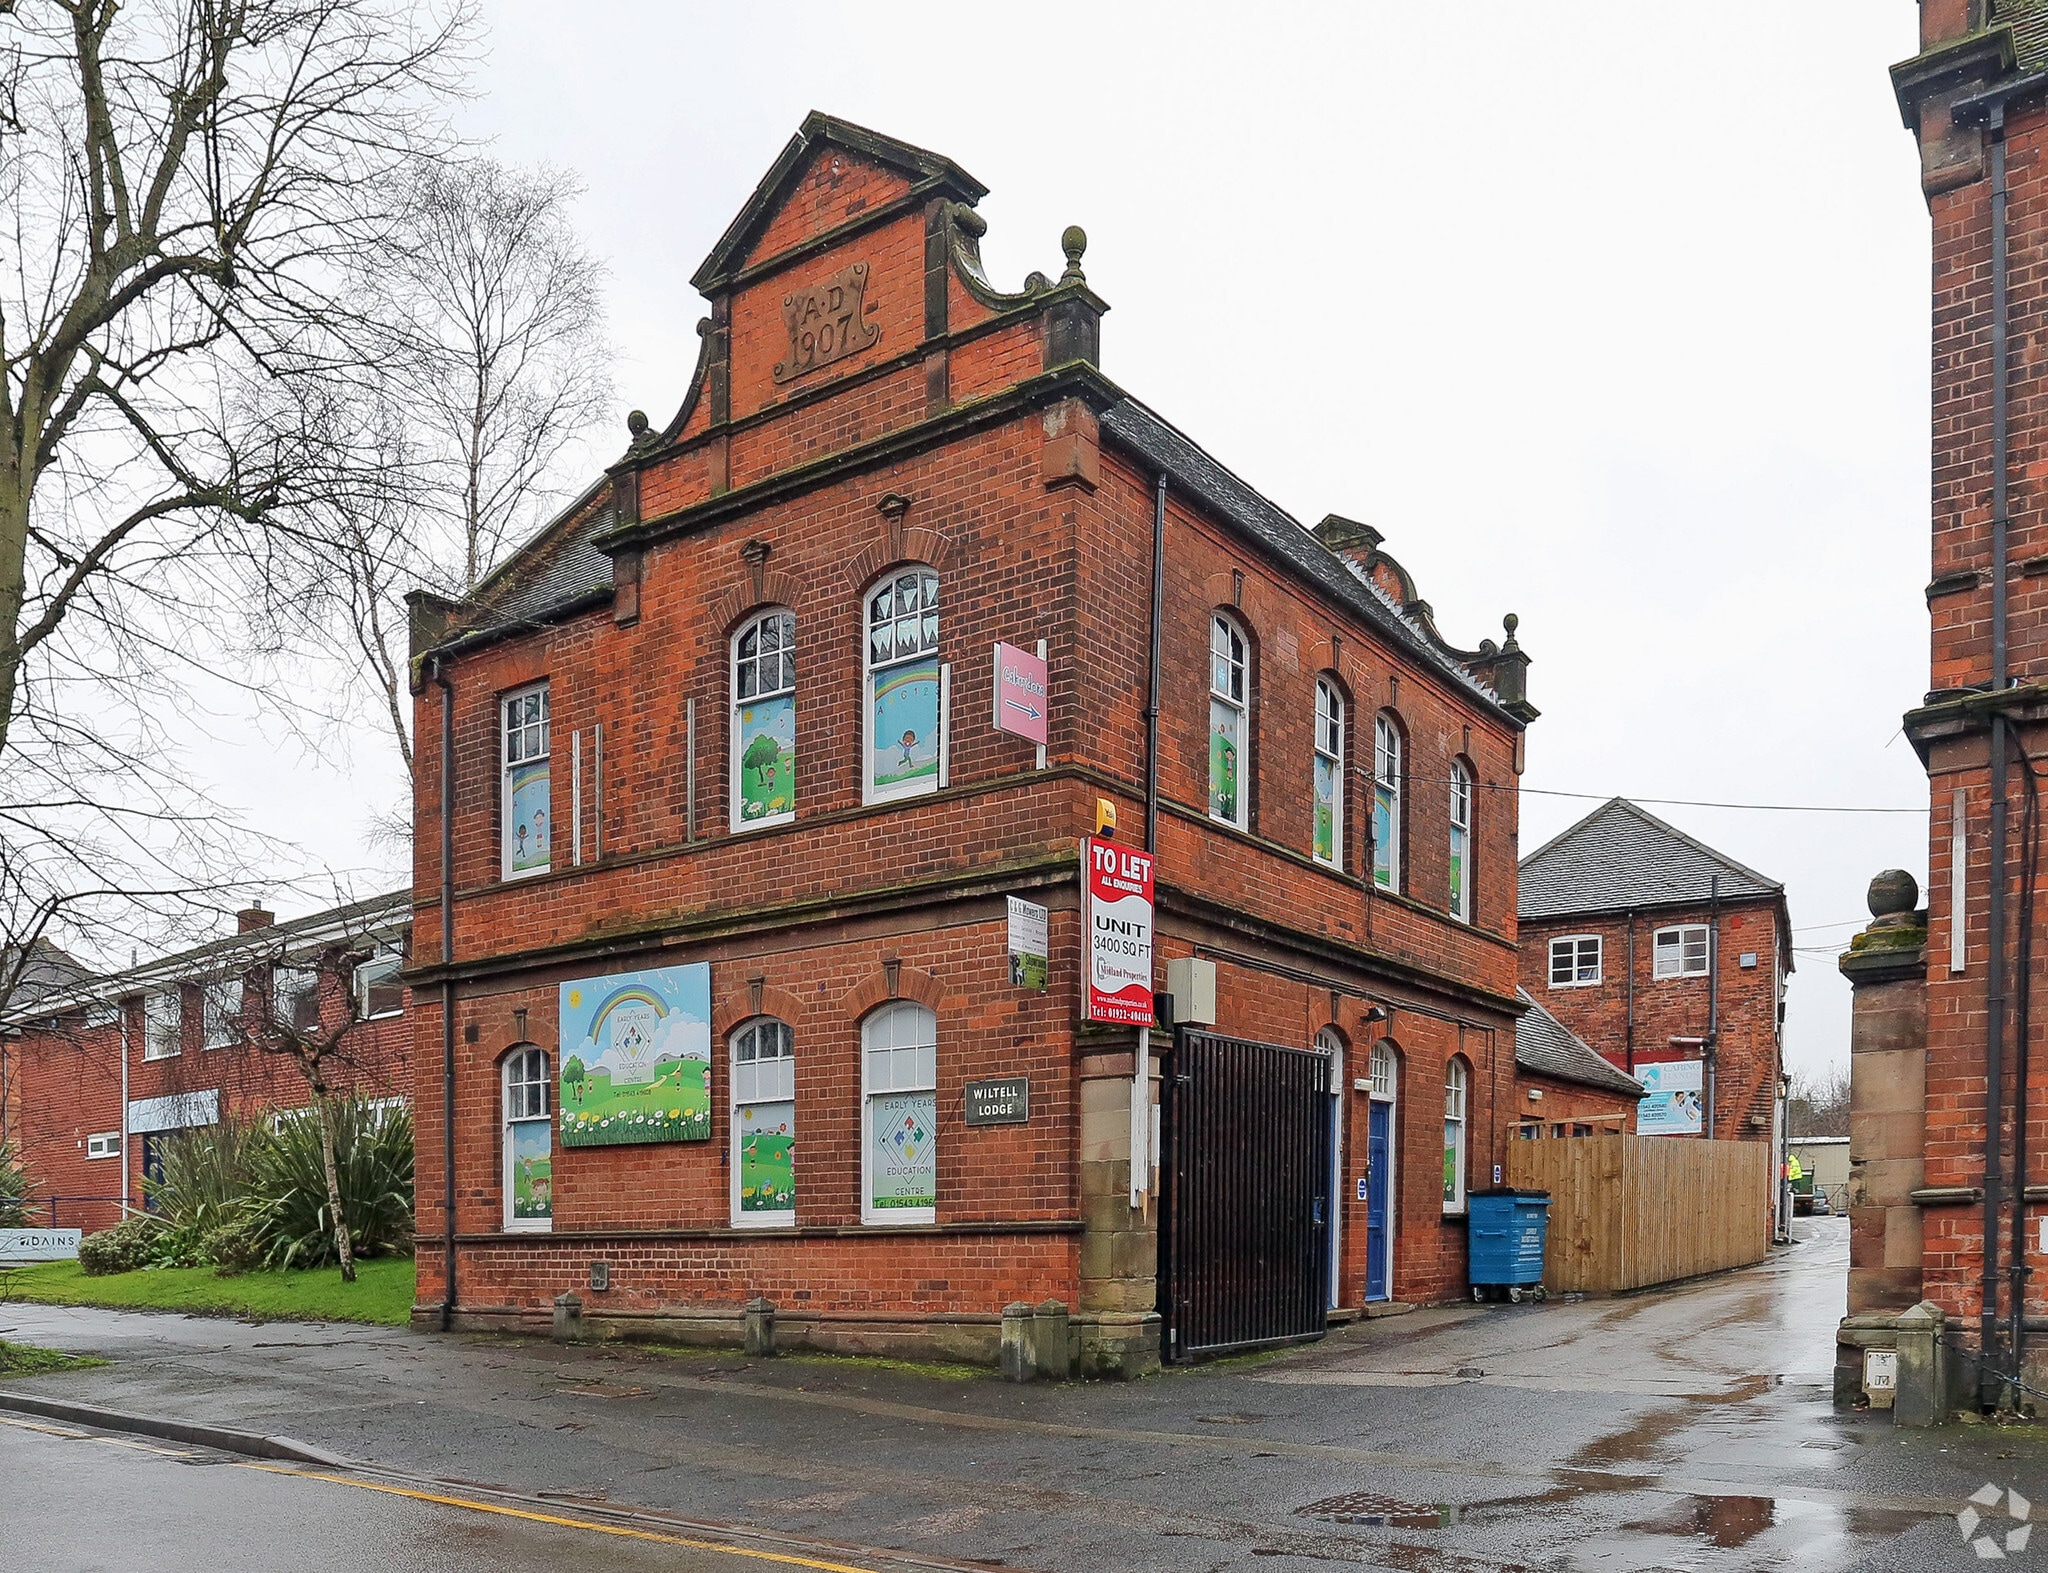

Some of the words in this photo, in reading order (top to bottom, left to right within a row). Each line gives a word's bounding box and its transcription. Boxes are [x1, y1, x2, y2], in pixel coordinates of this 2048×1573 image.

[1093, 845, 1117, 874] TO
[1121, 852, 1151, 882] LET
[1101, 875, 1113, 887] ALL
[1096, 915, 1146, 938] UNIT
[1094, 935, 1120, 953] 3400
[1122, 940, 1136, 957] SQ
[1138, 943, 1150, 959] FT
[1101, 964, 1122, 978] Midland
[1123, 968, 1148, 982] Properties
[1092, 1005, 1107, 1018] Tel:
[1663, 1062, 1700, 1072] CARING
[973, 1086, 1018, 1100] WILTELL
[884, 1101, 908, 1110] EARLY
[911, 1098, 936, 1108] YEARS
[978, 1103, 1013, 1116] LODGE
[886, 1166, 932, 1176] EDUCATION
[895, 1187, 925, 1196] CENTRE
[890, 1199, 913, 1208] 01543
[31, 1236, 75, 1246] DAINS
